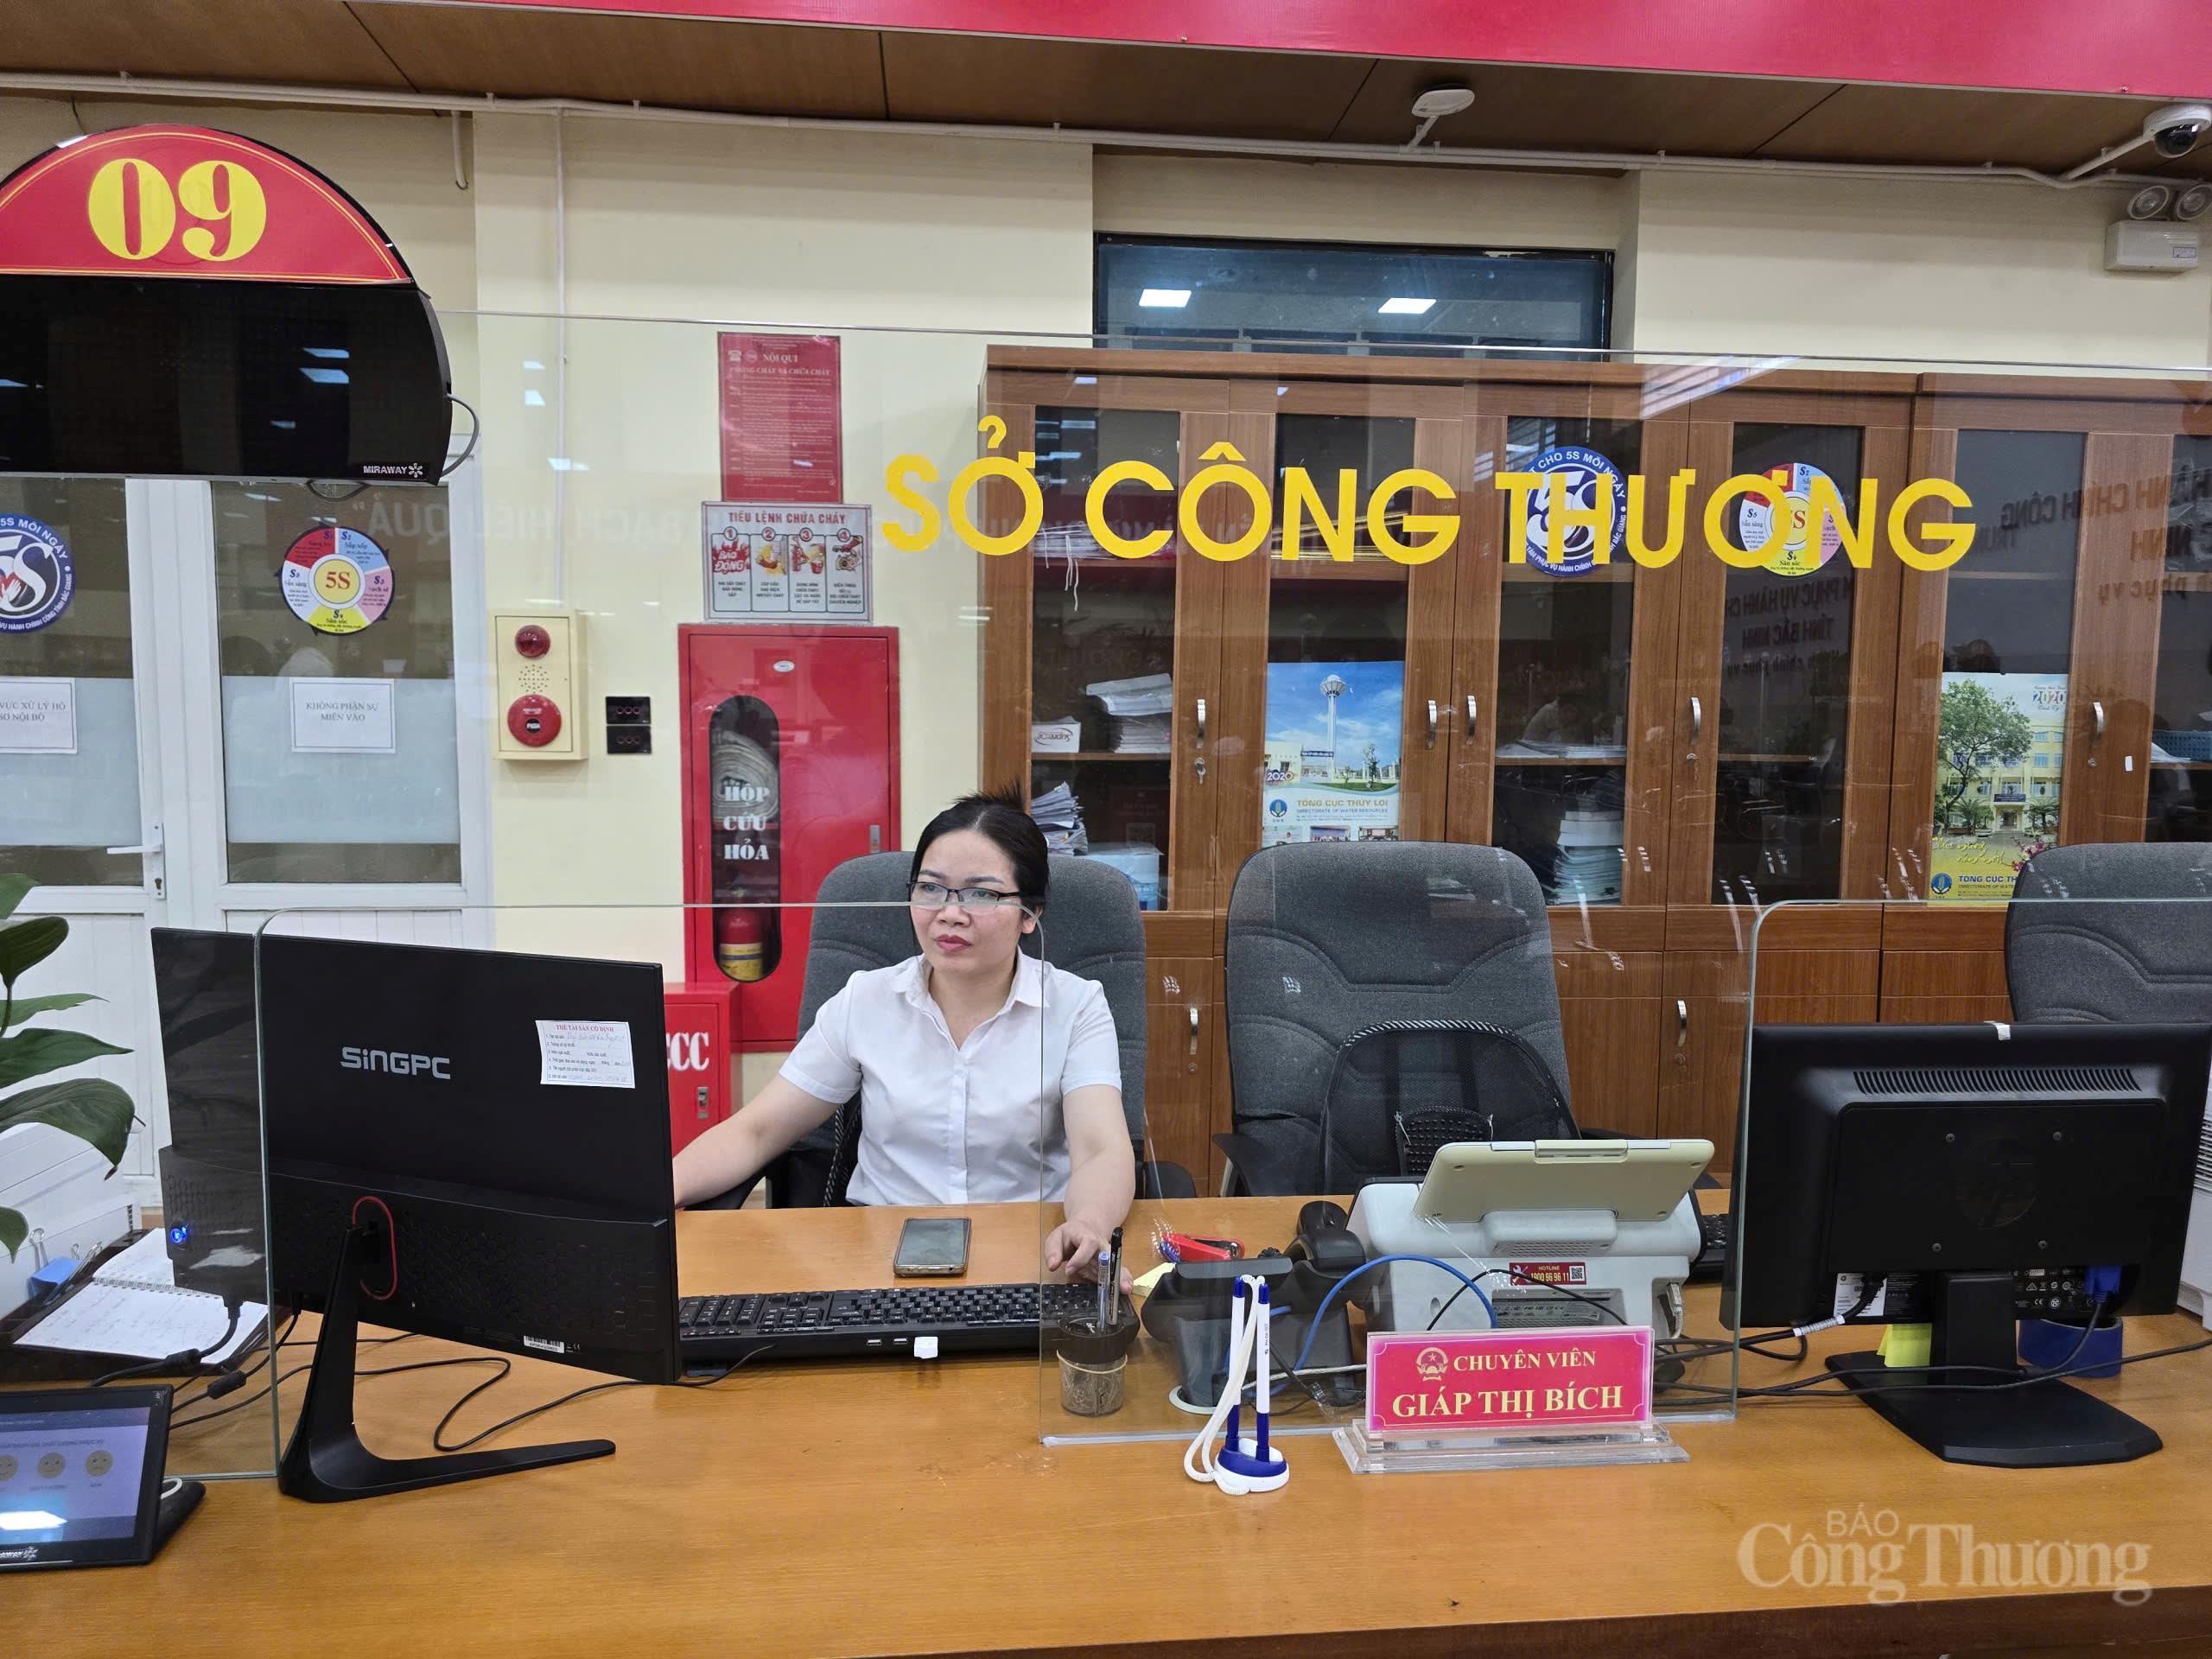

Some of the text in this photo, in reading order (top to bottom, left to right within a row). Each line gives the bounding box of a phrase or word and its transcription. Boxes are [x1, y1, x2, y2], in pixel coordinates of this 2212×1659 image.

[89, 158, 267, 261] 09
[363, 465, 408, 474] MIRAWAY
[1538, 452, 1562, 469] CHO
[1567, 451, 1580, 460] 5S
[882, 415, 1043, 555] SỞ
[1085, 442, 1460, 565] CÔNG
[1495, 468, 1975, 571] THƯƠNG
[755, 512, 782, 525] LỆNH
[786, 512, 815, 524] CHỮA
[818, 512, 846, 524] CHÁY
[1791, 510, 1806, 529] S
[325, 570, 351, 589] 5S
[306, 701, 338, 709] KHÔNG
[346, 712, 365, 721] VÀO
[1266, 772, 1294, 782] 2020
[724, 783, 771, 806] HỘP
[724, 837, 770, 861] HỎA
[1545, 1272, 1554, 1281] 96
[1554, 1272, 1561, 1281] 96
[1562, 1272, 1569, 1281] 11
[1453, 1347, 1596, 1371] CHUYÊN VIÊN
[1392, 1381, 1624, 1419] GIÁP THỊ BÍCH
